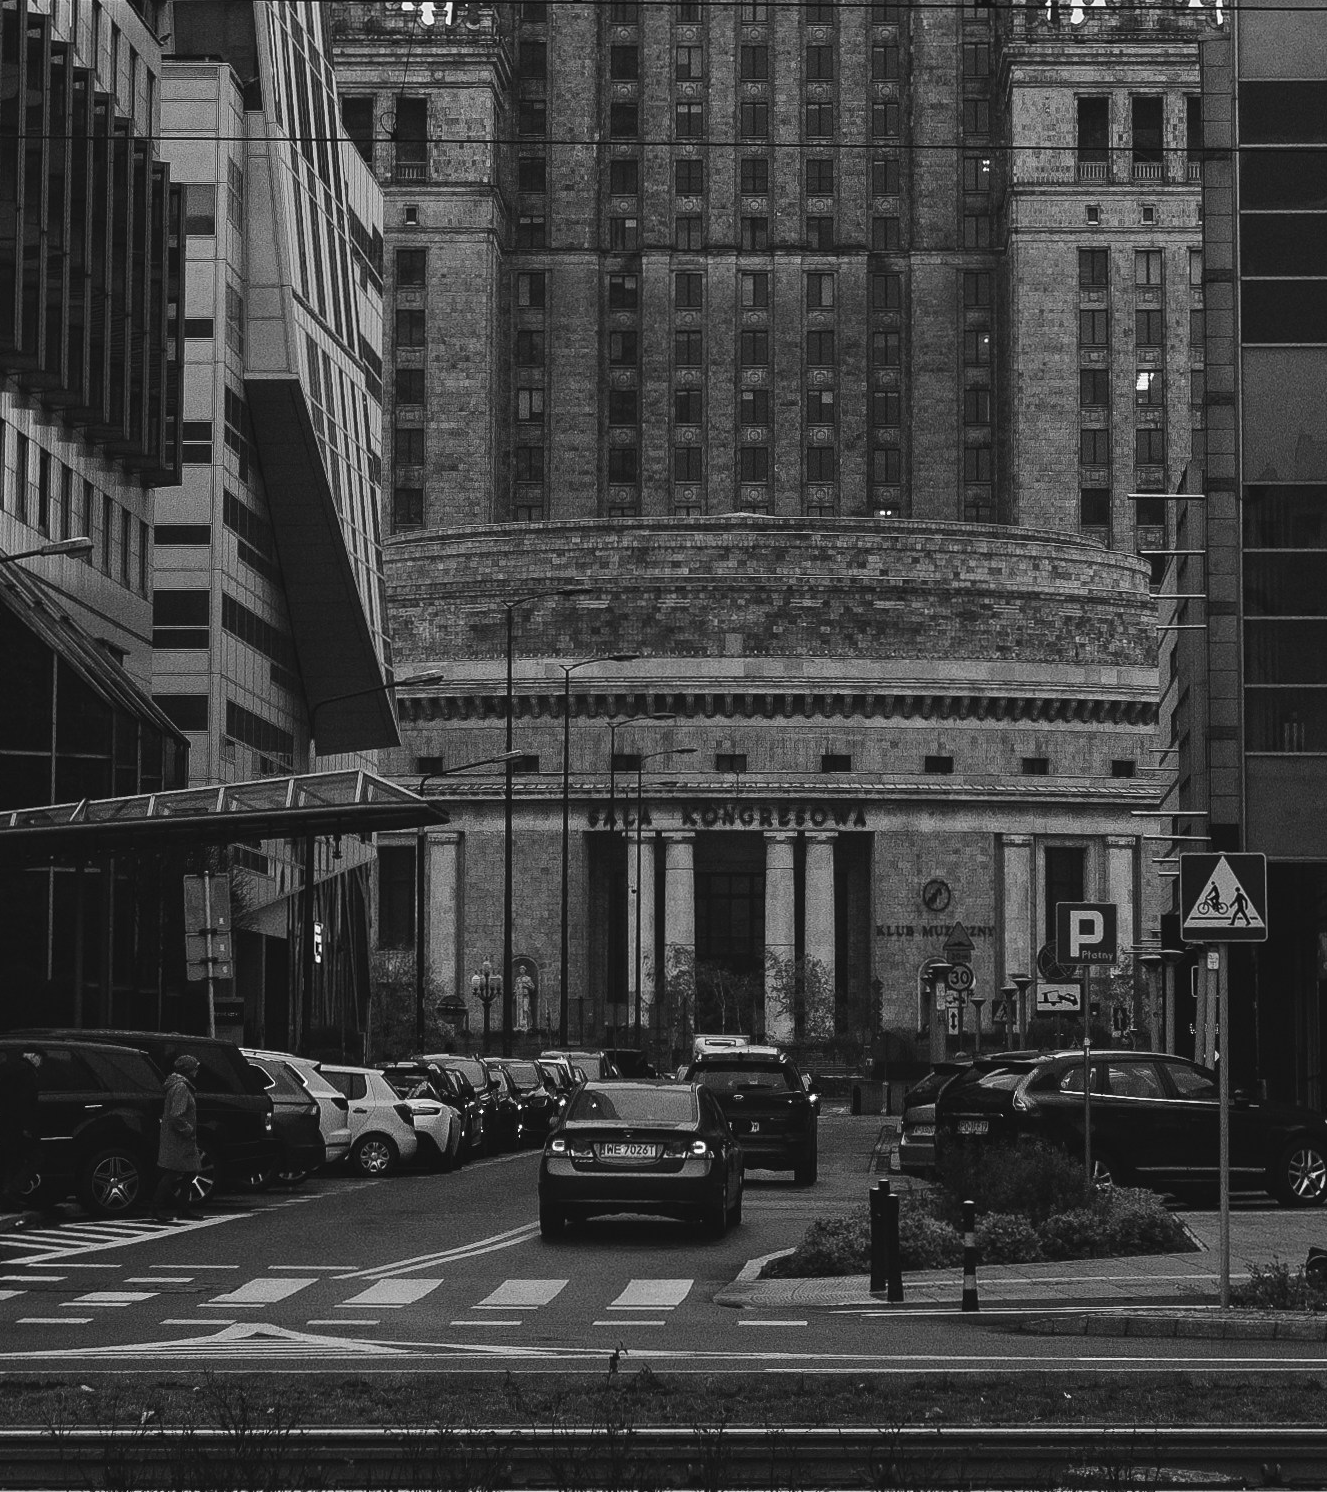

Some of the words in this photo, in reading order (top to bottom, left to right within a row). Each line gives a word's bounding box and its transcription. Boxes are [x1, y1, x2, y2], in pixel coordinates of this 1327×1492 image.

[586, 806, 653, 828] SALA
[681, 805, 867, 828] KONGRESOWA
[875, 925, 914, 937] KLUB
[922, 925, 996, 938] MUZZNY
[1070, 910, 1104, 958] P
[951, 971, 969, 985] 30
[605, 1143, 621, 1155] WE
[624, 1144, 655, 1155] 7026T
